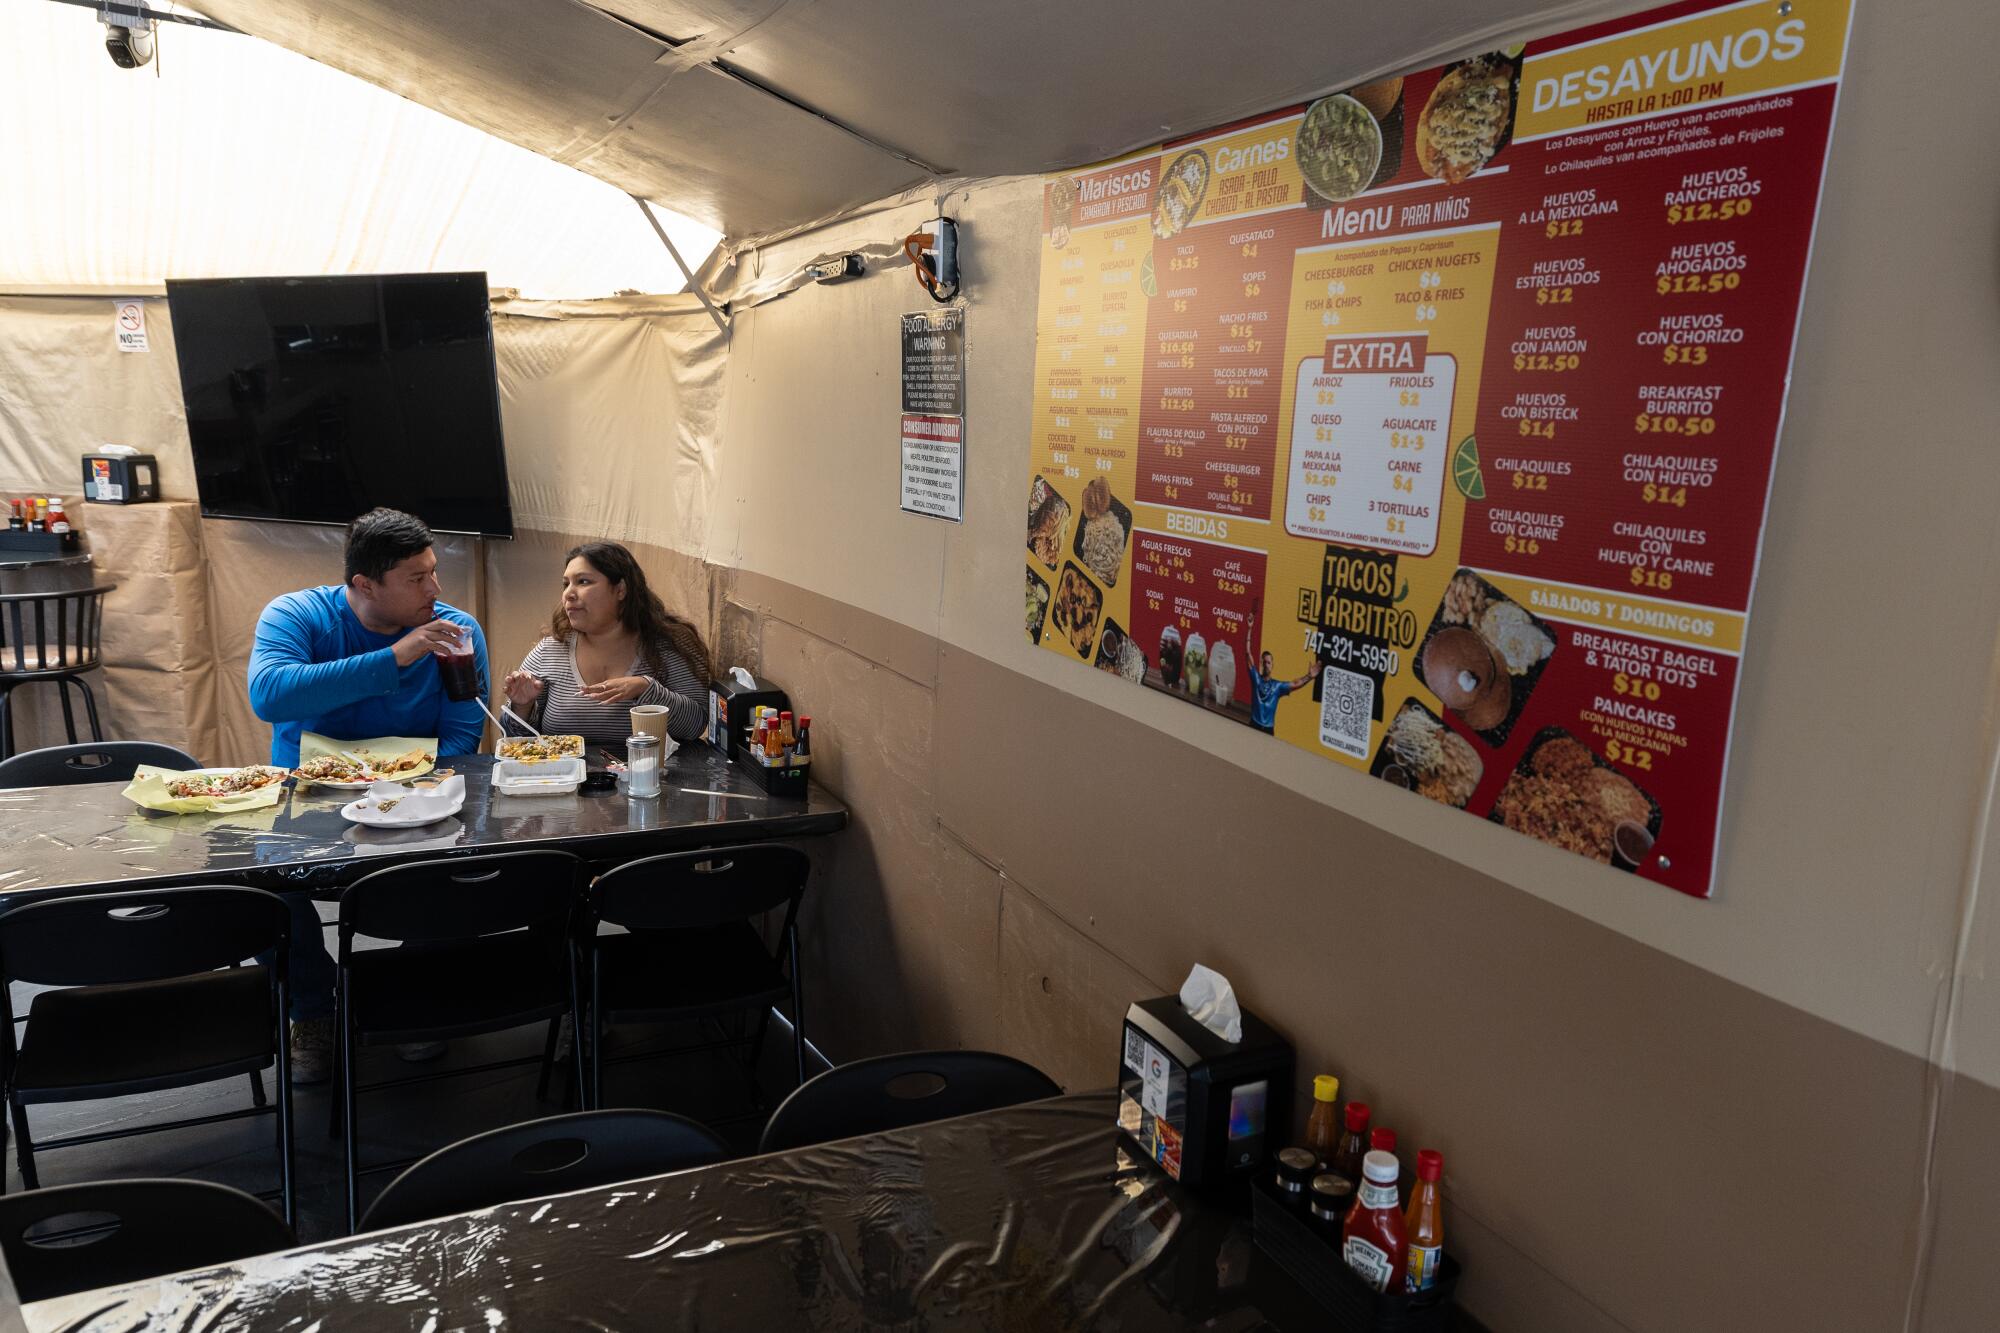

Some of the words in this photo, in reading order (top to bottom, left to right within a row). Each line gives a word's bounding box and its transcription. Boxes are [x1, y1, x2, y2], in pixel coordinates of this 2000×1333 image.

[1532, 19, 1806, 113] DESAYUNOS
[1586, 104, 1633, 124] HASTA
[1637, 95, 1656, 111] LA
[1661, 87, 1694, 108] 1:00
[1699, 81, 1724, 102] PM
[1546, 137, 1563, 150] Los
[1565, 128, 1620, 148] Desayunos
[1621, 124, 1642, 137] con
[1645, 117, 1679, 133] Huevo
[1682, 113, 1702, 126] van
[1704, 96, 1793, 122] acompañados
[1214, 137, 1289, 174] Carnes
[1545, 162, 1557, 174] Lo
[1559, 154, 1613, 174] Chilaquiles
[1616, 151, 1635, 163] van
[1637, 137, 1717, 161] acompañados
[1719, 132, 1735, 146] de
[1738, 126, 1784, 145] Frijoles
[1080, 169, 1150, 203] Mariscos
[1219, 175, 1243, 195] ASADA
[1253, 168, 1277, 188] POLLO
[1682, 167, 1748, 189] HUEVOS
[1543, 189, 1597, 208] HUEVOS
[1664, 180, 1762, 206] RANCHEROS
[1321, 205, 1393, 239] Menu
[1400, 203, 1430, 228] PARA
[1433, 196, 1470, 223] NIÑOS
[1518, 213, 1527, 224] A
[1530, 210, 1546, 223] LA
[1548, 200, 1618, 221] MEXICANA
[1667, 199, 1752, 225] $12.50
[1230, 229, 1275, 245] QUESATACO
[1545, 219, 1583, 239] $12
[1671, 241, 1735, 260] HUEVOS
[1388, 258, 1432, 273] CHICKEN
[1435, 252, 1481, 268] NUGETS
[1533, 258, 1585, 275] HUEVOS
[1656, 256, 1746, 276] AHOGADOS
[1243, 272, 1266, 282] SOPES
[1305, 264, 1374, 281] CHEESEBURGER
[1516, 271, 1600, 289] ESTRELLADOS
[1656, 272, 1740, 295] $12.50
[1394, 291, 1421, 305] TACO
[1424, 291, 1433, 302] &
[1435, 288, 1465, 300] FRIES
[1536, 288, 1573, 305] $12
[905, 319, 922, 333] FOOD
[923, 316, 957, 332] ALLERGY
[1219, 313, 1245, 324] NACHO
[1247, 312, 1268, 321] FRIES
[1660, 314, 1724, 330] HUEVOS
[120, 333, 132, 343] NO
[1231, 324, 1253, 338] $15
[1525, 327, 1576, 340] HUEVOS
[1637, 331, 1669, 345] CON
[1672, 328, 1744, 344] CHORIZO
[914, 336, 946, 350] WARNING
[1511, 341, 1537, 354] CON
[1540, 340, 1587, 353] JAMON
[1332, 342, 1414, 369] EXTRA
[1514, 354, 1580, 372] $12.50
[1663, 344, 1708, 365] $13
[1312, 377, 1343, 388] ARROZ
[1389, 376, 1434, 388] FRIJOLES
[1164, 387, 1192, 397] BURRITO
[1317, 390, 1335, 407] $2
[1516, 393, 1566, 407] HUEVOS
[1638, 386, 1723, 400] BREAKFAST
[1501, 406, 1527, 418] CON
[1530, 407, 1579, 420] BISTECK
[1646, 400, 1713, 415] BURRITO
[1211, 412, 1232, 422] PASTA
[1234, 413, 1268, 423] ALFREDO
[1311, 414, 1342, 426] QUESO
[1382, 418, 1437, 431] AGUACATE
[1635, 412, 1716, 435] $10.50
[904, 420, 931, 435] CONSUMER
[932, 422, 960, 438] ADVISORY
[1147, 427, 1172, 437] FLAUTAS
[1174, 429, 1182, 437] DE
[1184, 429, 1205, 439] POLLO
[1217, 424, 1233, 433] CON
[1234, 425, 1258, 435] POLLO
[1519, 418, 1555, 439] $14
[1225, 435, 1247, 450] $17
[1305, 450, 1323, 460] PAPA
[1331, 452, 1341, 461] LA
[1623, 453, 1719, 473] CHILAQUILES
[1205, 462, 1260, 475] CHEESEBURGER
[1302, 461, 1341, 473] MEXICANA
[1388, 460, 1422, 473] CARNE
[1495, 458, 1572, 475] CHILAQUILES
[1152, 474, 1171, 484] PAPAS
[1172, 475, 1193, 486] FRITAS
[1223, 474, 1238, 488] $8
[1305, 471, 1337, 487] $2.50
[1512, 471, 1548, 491] $12
[1623, 468, 1654, 483] CON
[1658, 471, 1713, 487] HUEVO
[1306, 493, 1331, 506] CHIPS
[1642, 483, 1687, 507] $14
[1377, 501, 1429, 518] TORTILLAS
[1488, 508, 1565, 527] CHILAQUILES
[1167, 512, 1228, 539] BEBIDAS
[1490, 522, 1516, 537] CON
[1518, 524, 1559, 541] CARNE
[1613, 521, 1706, 545] CHILAQUILES
[1141, 539, 1163, 552] AGUAS
[1163, 544, 1192, 558] FRESCAS
[1504, 535, 1540, 555] $16
[1640, 539, 1672, 555] CON
[1225, 561, 1241, 571] CAFÉ
[1598, 549, 1648, 567] HUEVO
[1651, 556, 1661, 569] Y
[1663, 557, 1715, 577] CARNE
[1213, 568, 1227, 578] CON
[1227, 572, 1253, 584] CANELA
[1326, 555, 1393, 598] TACOS
[1630, 566, 1673, 590] $18
[1146, 589, 1164, 600] SODAS
[1217, 578, 1245, 595] $2.50
[1174, 597, 1199, 609] BOTELLA
[1174, 606, 1182, 614] DE
[1182, 608, 1199, 619] AGUA
[1212, 607, 1244, 622] CAPRISUN
[1298, 587, 1319, 625] EL
[1325, 588, 1416, 648] ÁRBITRO
[1530, 588, 1600, 616] SÁBADOS
[1605, 603, 1617, 620] Y
[1619, 606, 1715, 637] DOMINGOS
[1216, 618, 1238, 634] $.75
[1304, 628, 1399, 676] 747-321-5950
[1572, 631, 1660, 663] BREAKFAST
[1662, 649, 1718, 676] BAGEL
[1585, 650, 1598, 666] &
[1603, 654, 1651, 679] TATOR
[1656, 665, 1697, 689] TOTS
[1613, 672, 1661, 701] $10
[1594, 696, 1676, 731] PANCAKES
[1580, 710, 1604, 725] (CON
[1606, 717, 1646, 737] HUEVOS
[1655, 730, 1688, 748] PAPAS
[1605, 738, 1653, 771] $12
[1355, 1246, 1376, 1259] HEINZ
[1352, 1257, 1378, 1275] TOMATO
